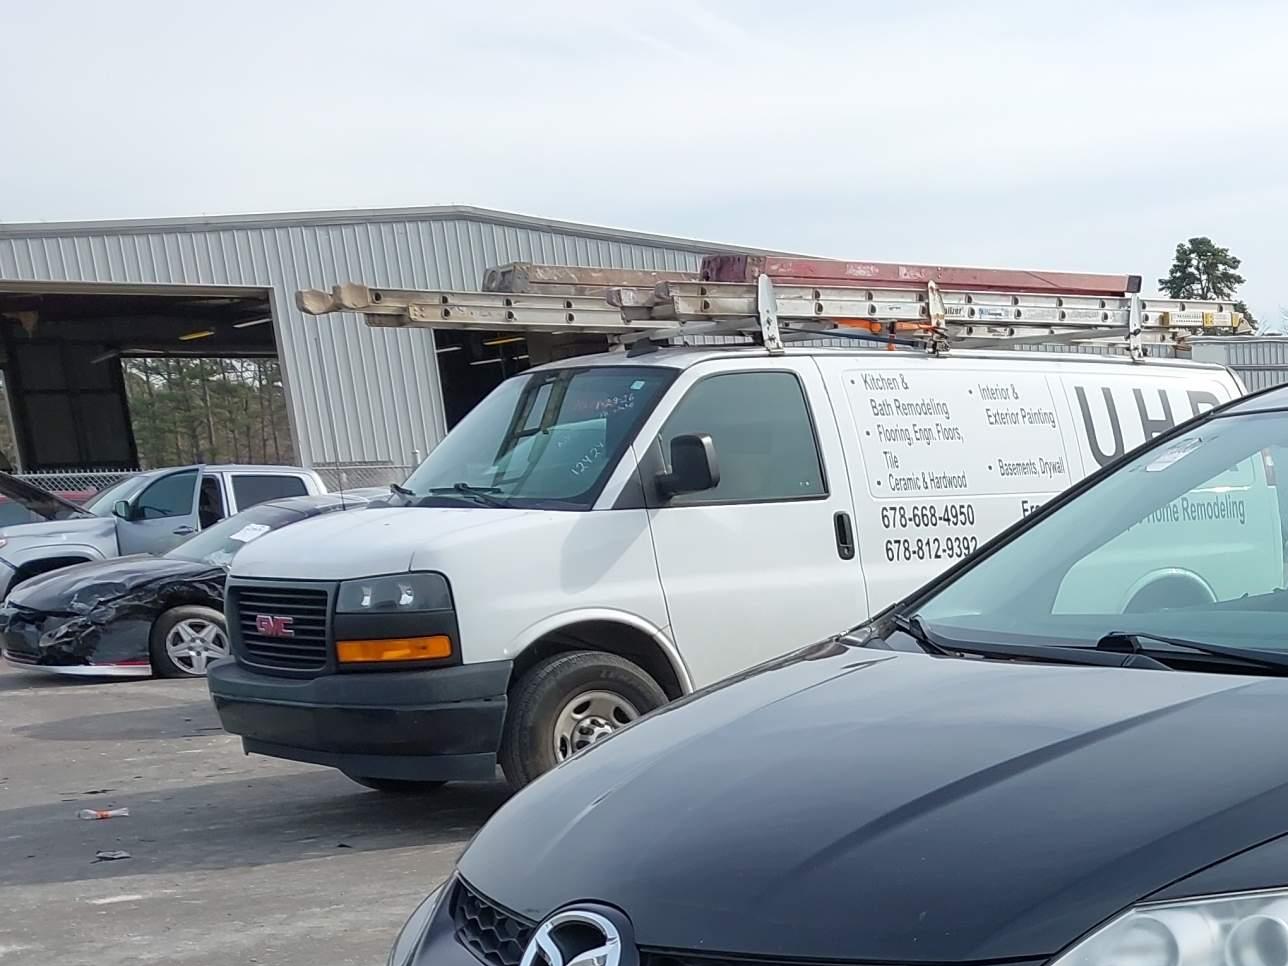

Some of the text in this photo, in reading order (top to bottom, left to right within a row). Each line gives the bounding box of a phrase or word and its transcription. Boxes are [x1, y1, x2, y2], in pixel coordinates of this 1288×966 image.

[861, 373, 909, 390] Kitchen &
[978, 383, 1019, 400] Interior &
[870, 397, 950, 420] Bath Remodeling
[985, 407, 1056, 428] Exterior Painting
[877, 423, 964, 445] Flooring, Engn. Floors,
[883, 451, 899, 469] Tile
[998, 456, 1065, 479] Basements, Drywall
[889, 470, 968, 491] Ceramic & Hardwood
[881, 503, 975, 528] 678-668-4950
[1181, 494, 1246, 525] Remodeling
[885, 536, 978, 561] 678-812-9392
[255, 614, 295, 638] GMC
